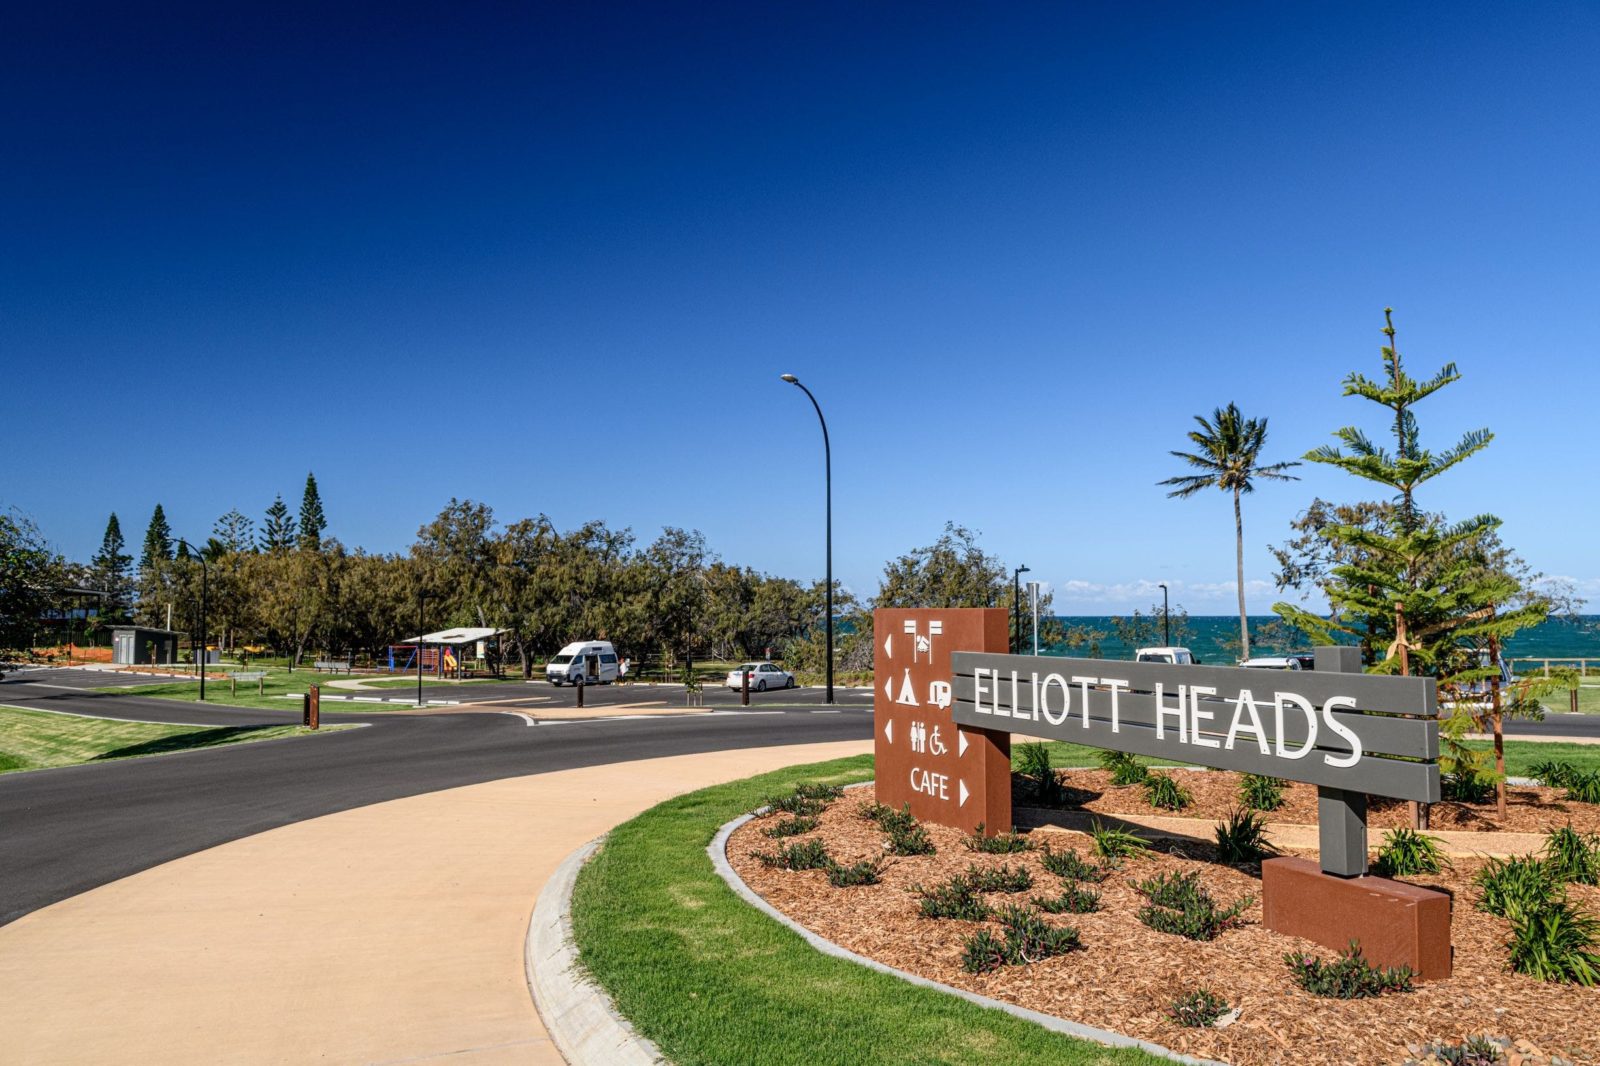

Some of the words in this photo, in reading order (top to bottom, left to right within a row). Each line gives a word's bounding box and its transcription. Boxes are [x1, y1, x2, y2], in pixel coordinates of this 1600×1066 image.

[974, 668, 1129, 733] ELLIOTT
[1155, 682, 1362, 768] HEADS
[911, 768, 949, 800] CAFE
